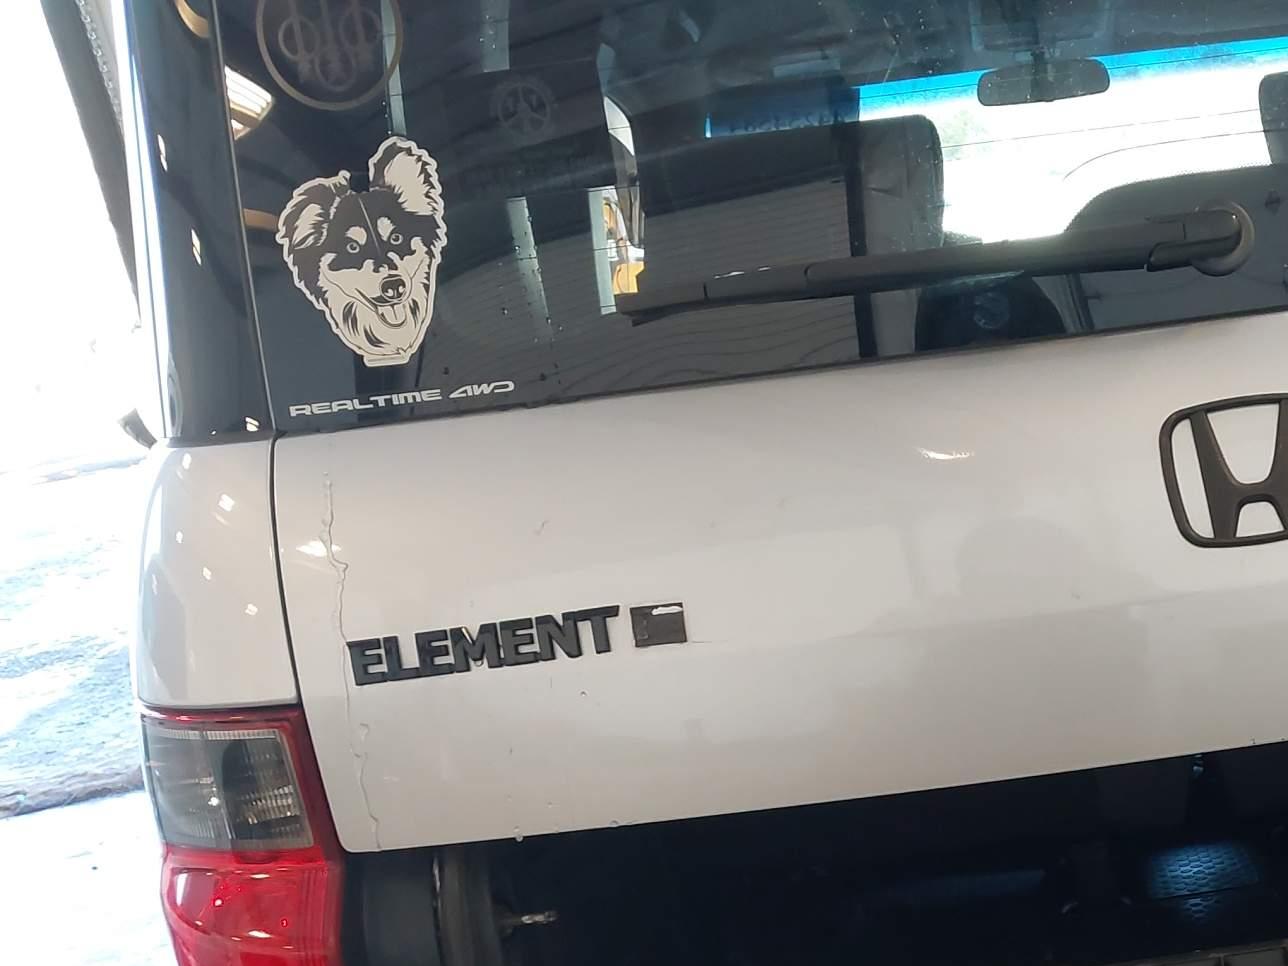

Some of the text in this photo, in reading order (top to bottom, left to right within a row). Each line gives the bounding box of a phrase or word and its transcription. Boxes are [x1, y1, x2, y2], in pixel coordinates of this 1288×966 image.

[289, 380, 515, 417] REALTIME 4WD
[346, 604, 620, 687] ELEMENT
